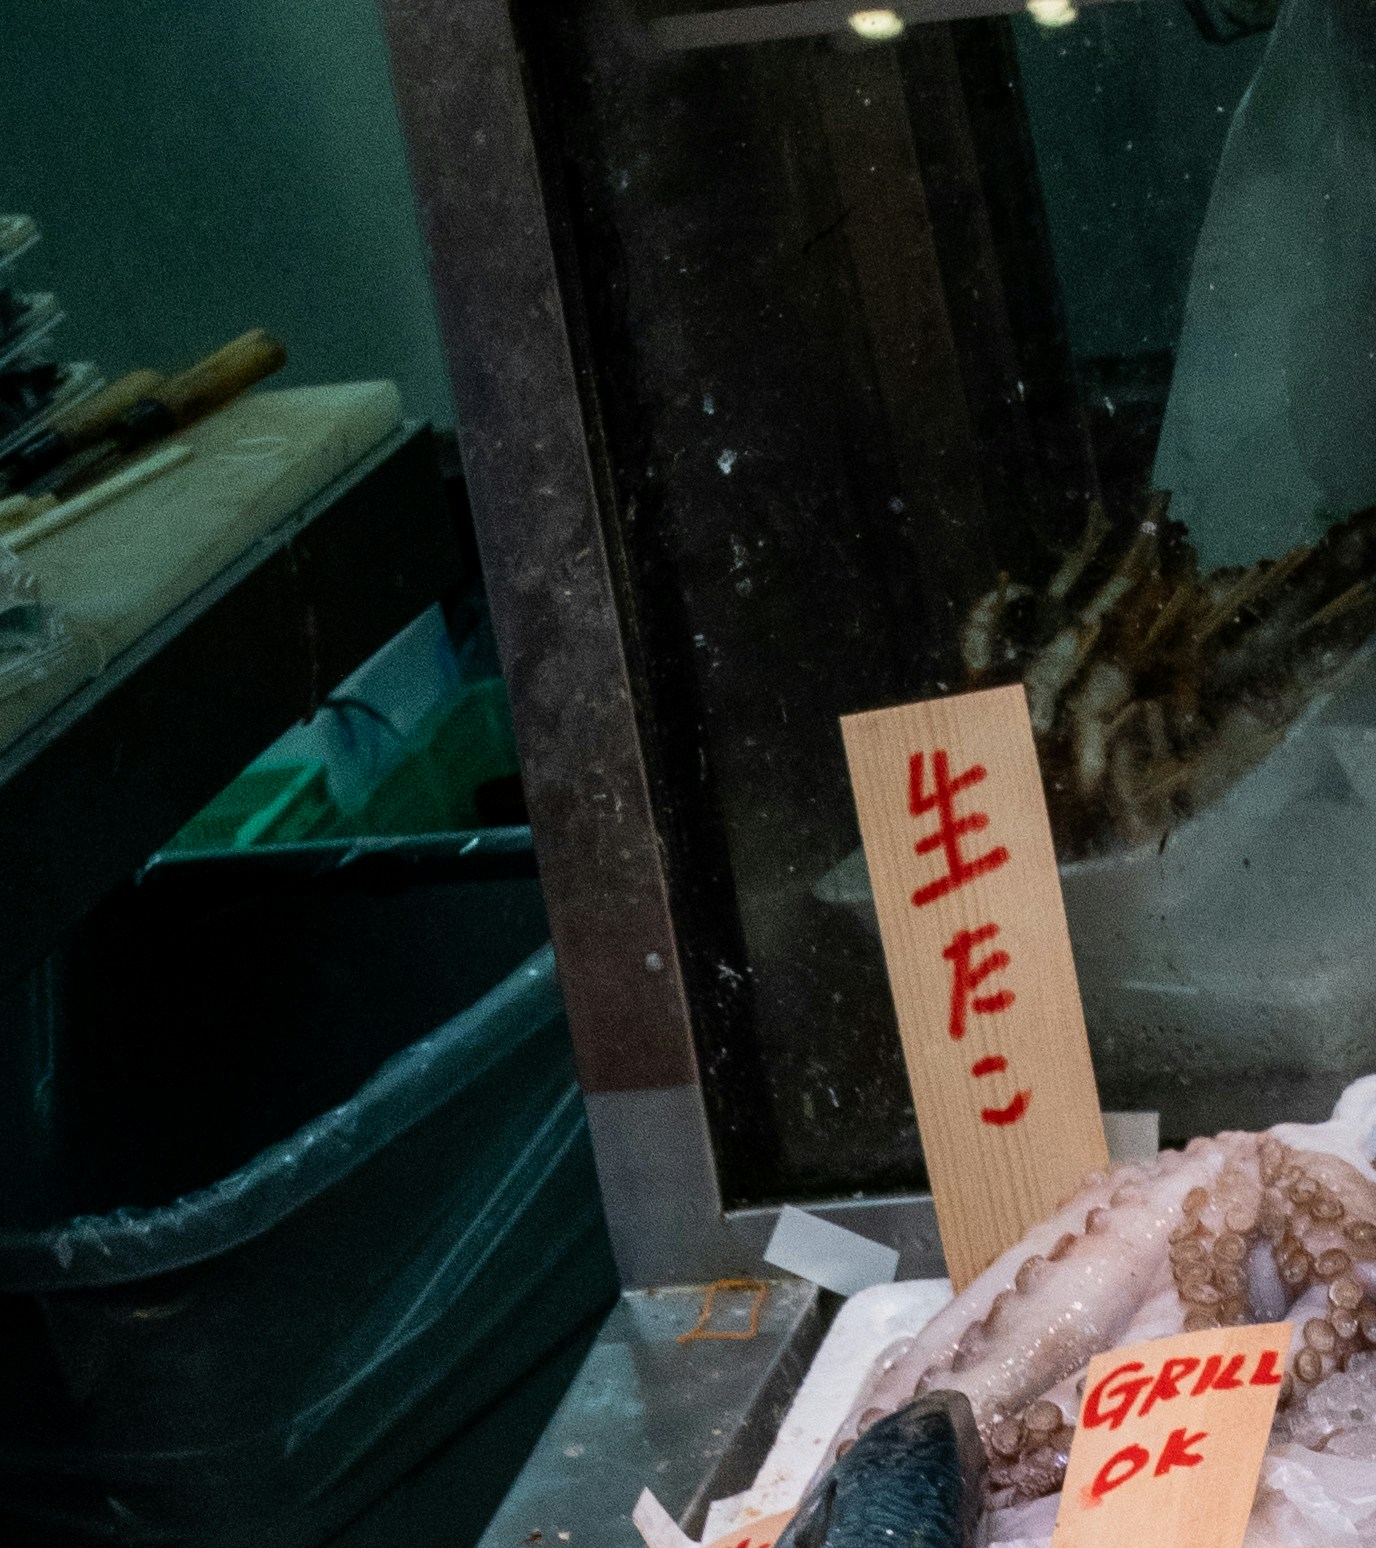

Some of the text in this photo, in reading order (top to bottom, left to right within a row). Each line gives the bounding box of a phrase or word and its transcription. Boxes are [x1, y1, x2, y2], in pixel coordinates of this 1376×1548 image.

[909, 752, 1029, 1125] 生たこ
[1081, 1350, 1282, 1431] GRILL
[1088, 1428, 1211, 1500] OK
